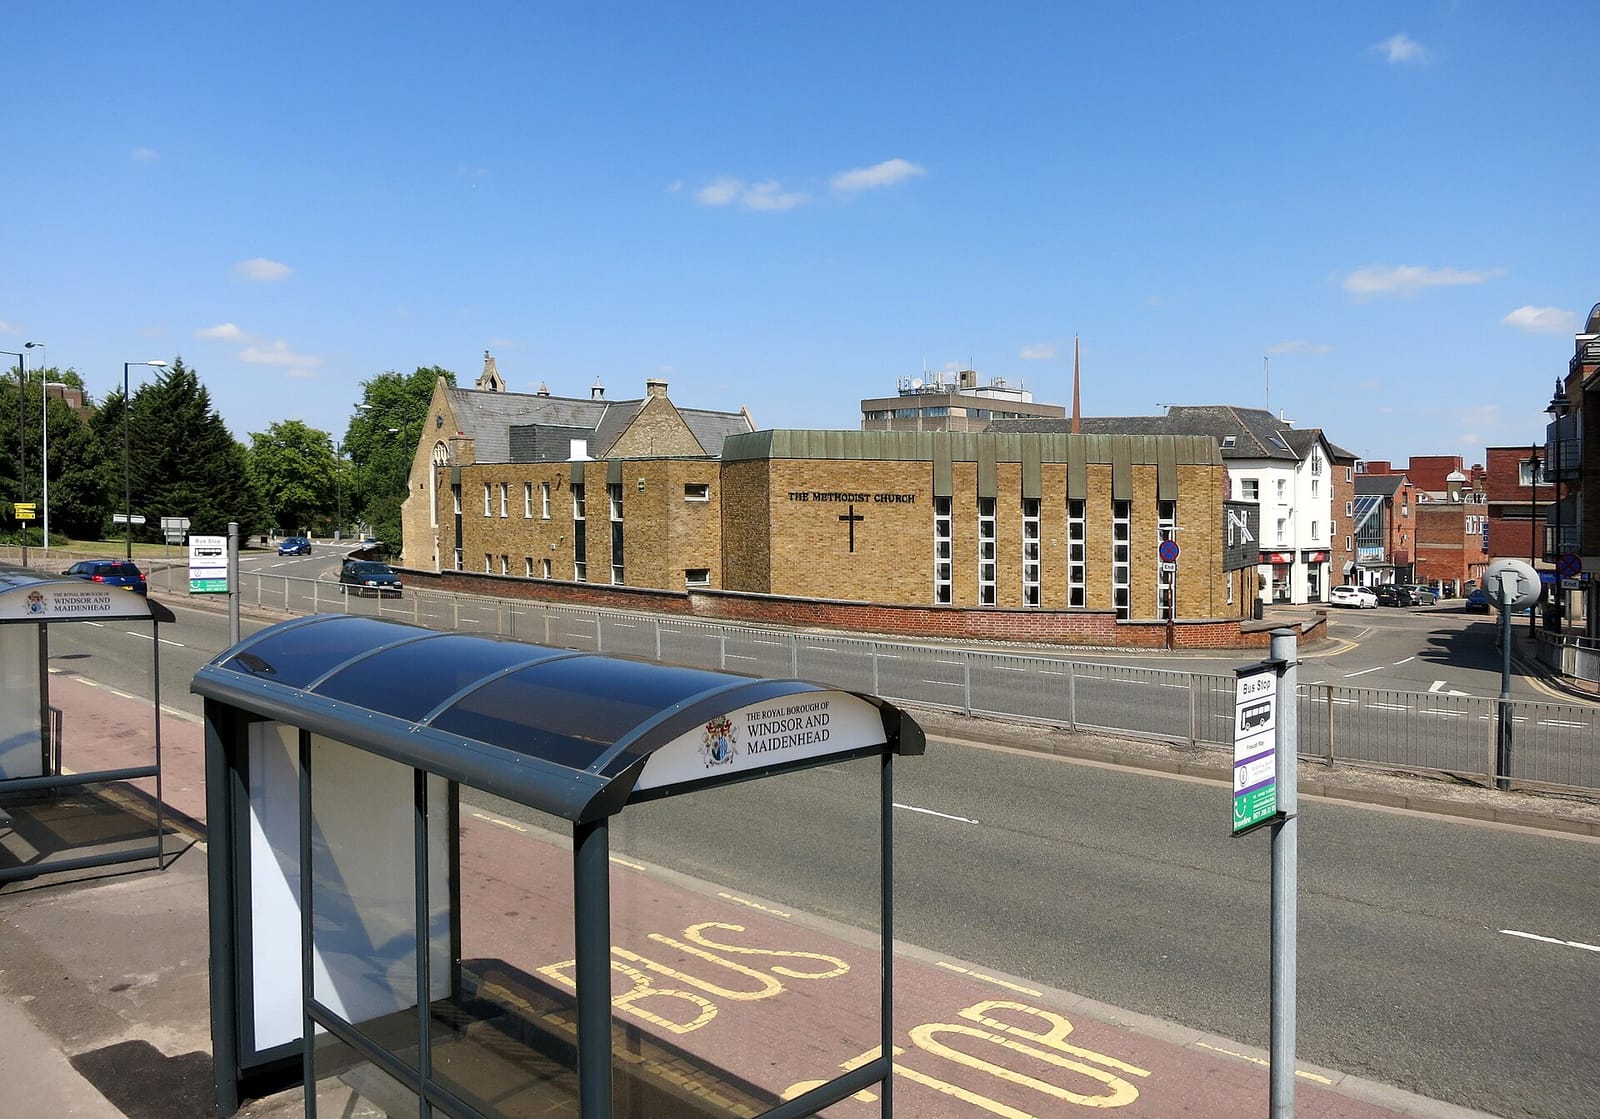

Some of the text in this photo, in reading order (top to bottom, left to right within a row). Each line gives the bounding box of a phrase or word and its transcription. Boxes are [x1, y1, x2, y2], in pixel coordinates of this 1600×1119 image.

[788, 492, 915, 503] THE METHODIST CHURCH
[1243, 679, 1271, 695] Bus Stop
[746, 701, 830, 721] THE ROYAL BOROUGH OF
[747, 713, 830, 738] WINDSOR AND
[747, 729, 830, 754] MAIDENHEAD
[535, 921, 851, 1034] BUS
